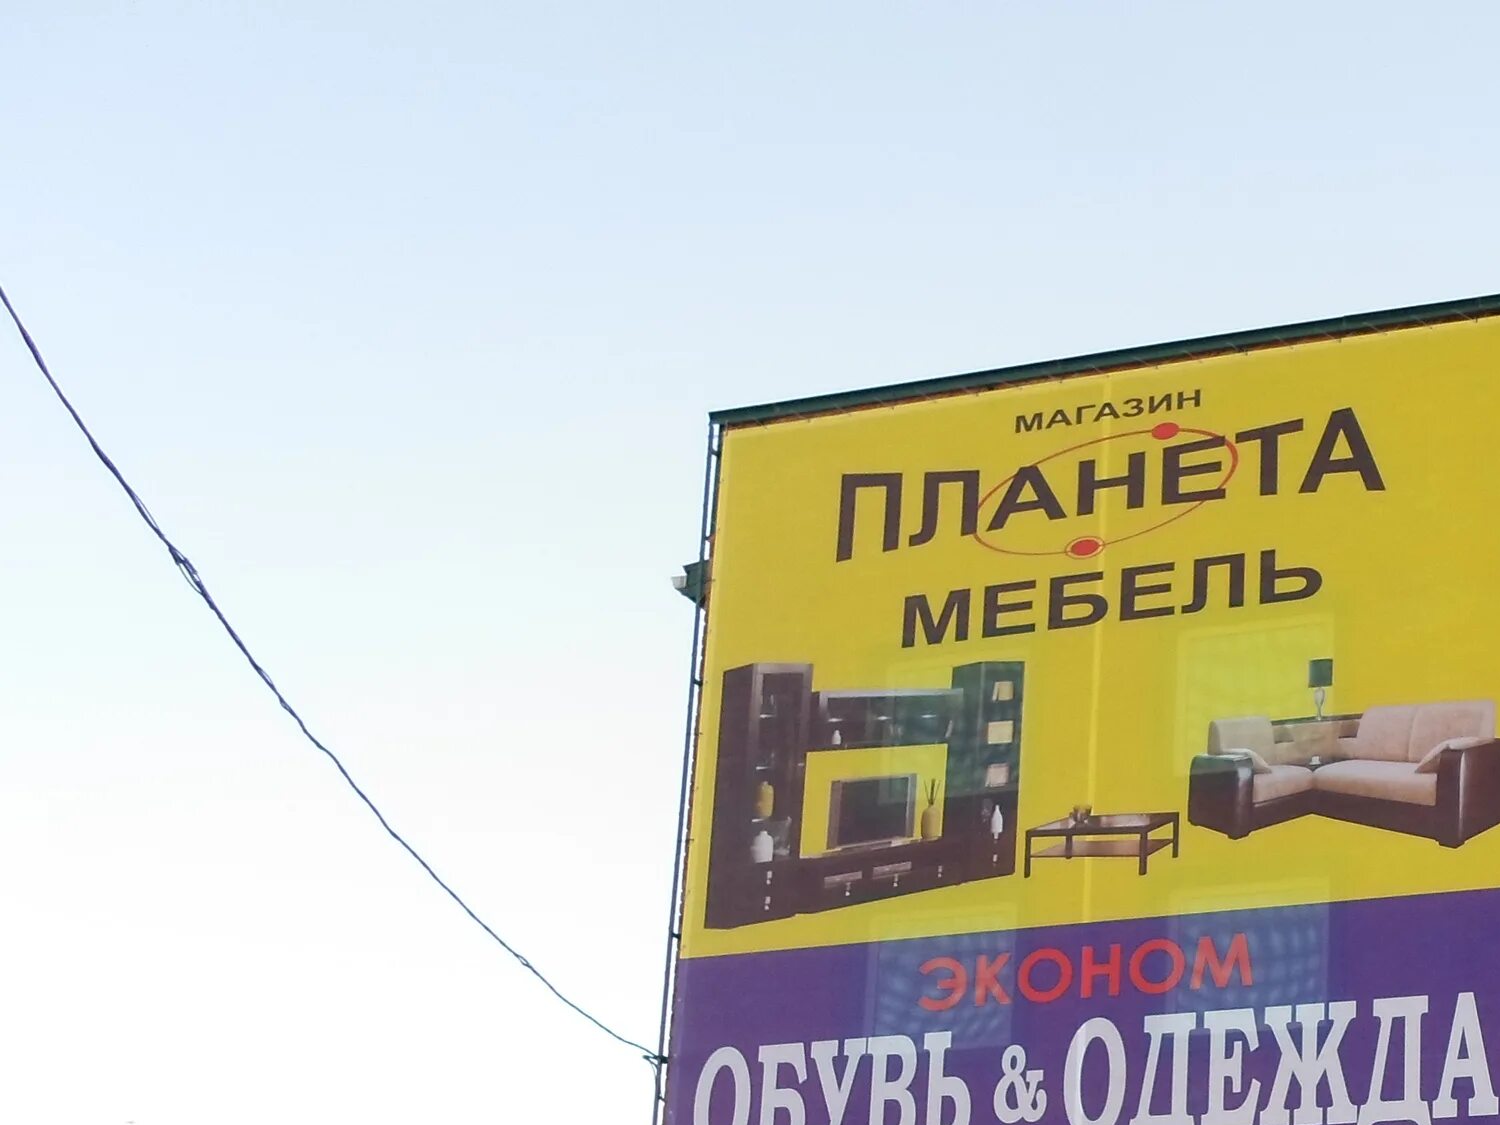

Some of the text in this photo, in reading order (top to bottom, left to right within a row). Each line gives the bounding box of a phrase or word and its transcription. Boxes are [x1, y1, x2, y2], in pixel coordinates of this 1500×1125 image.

[1015, 388, 1202, 434] МАГАЗИН
[834, 406, 1386, 563] ПЛАНЕТА
[900, 548, 1324, 648] МЕБЕЛЬ
[917, 933, 1254, 1012] ЭКОНОМ
[994, 1044, 1048, 1124] &
